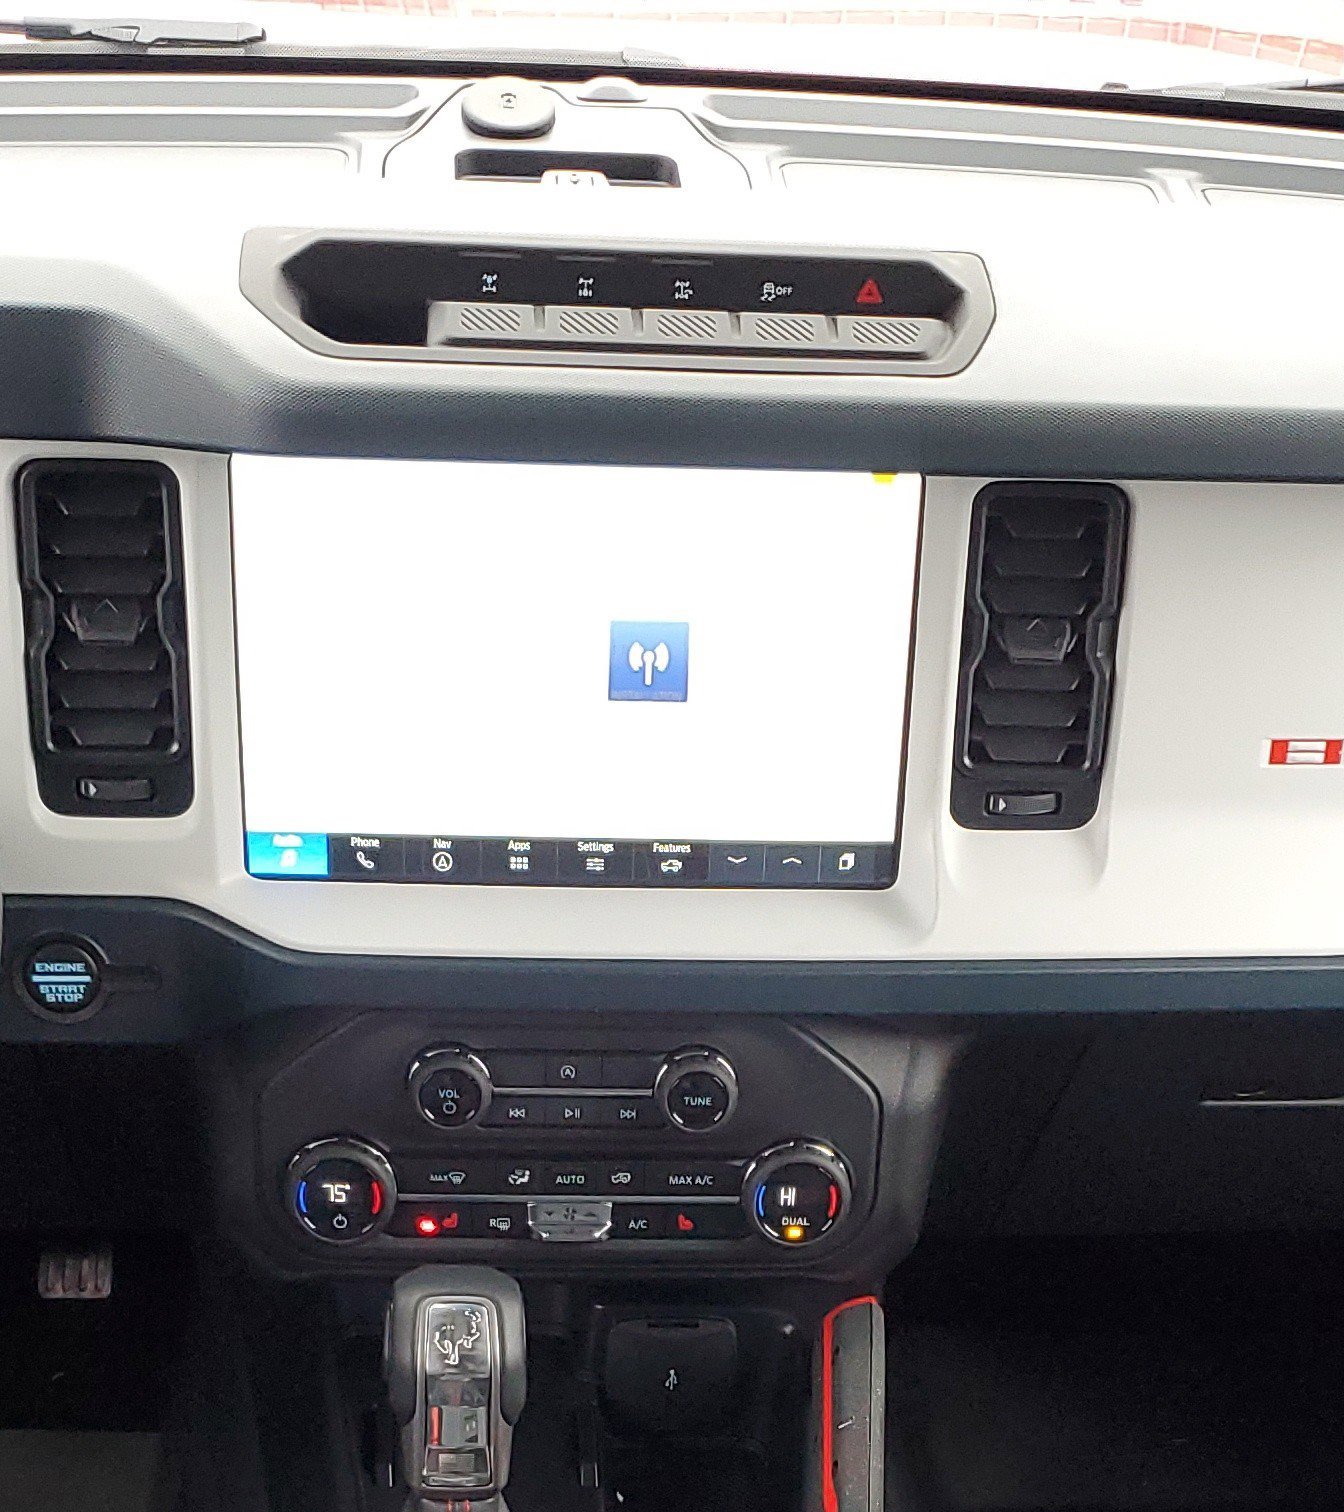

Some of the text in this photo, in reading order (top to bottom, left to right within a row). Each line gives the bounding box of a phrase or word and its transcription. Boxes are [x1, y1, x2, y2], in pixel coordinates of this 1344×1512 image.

[776, 286, 793, 295] OFF
[350, 836, 380, 848] Phone
[433, 838, 452, 849] Nav
[507, 839, 531, 852] Apps
[577, 841, 614, 854] Settings
[653, 842, 692, 854] Features
[35, 962, 86, 972] ENGINE
[39, 984, 86, 994] START
[46, 993, 84, 1003] STOP
[438, 1089, 460, 1099] VOL
[683, 1096, 713, 1107] TUNE
[556, 1175, 585, 1184] AUTO
[669, 1175, 713, 1185] MAX A/C
[780, 1187, 796, 1207] HI
[628, 1219, 648, 1230] A/C
[782, 1216, 810, 1226] DUAL
